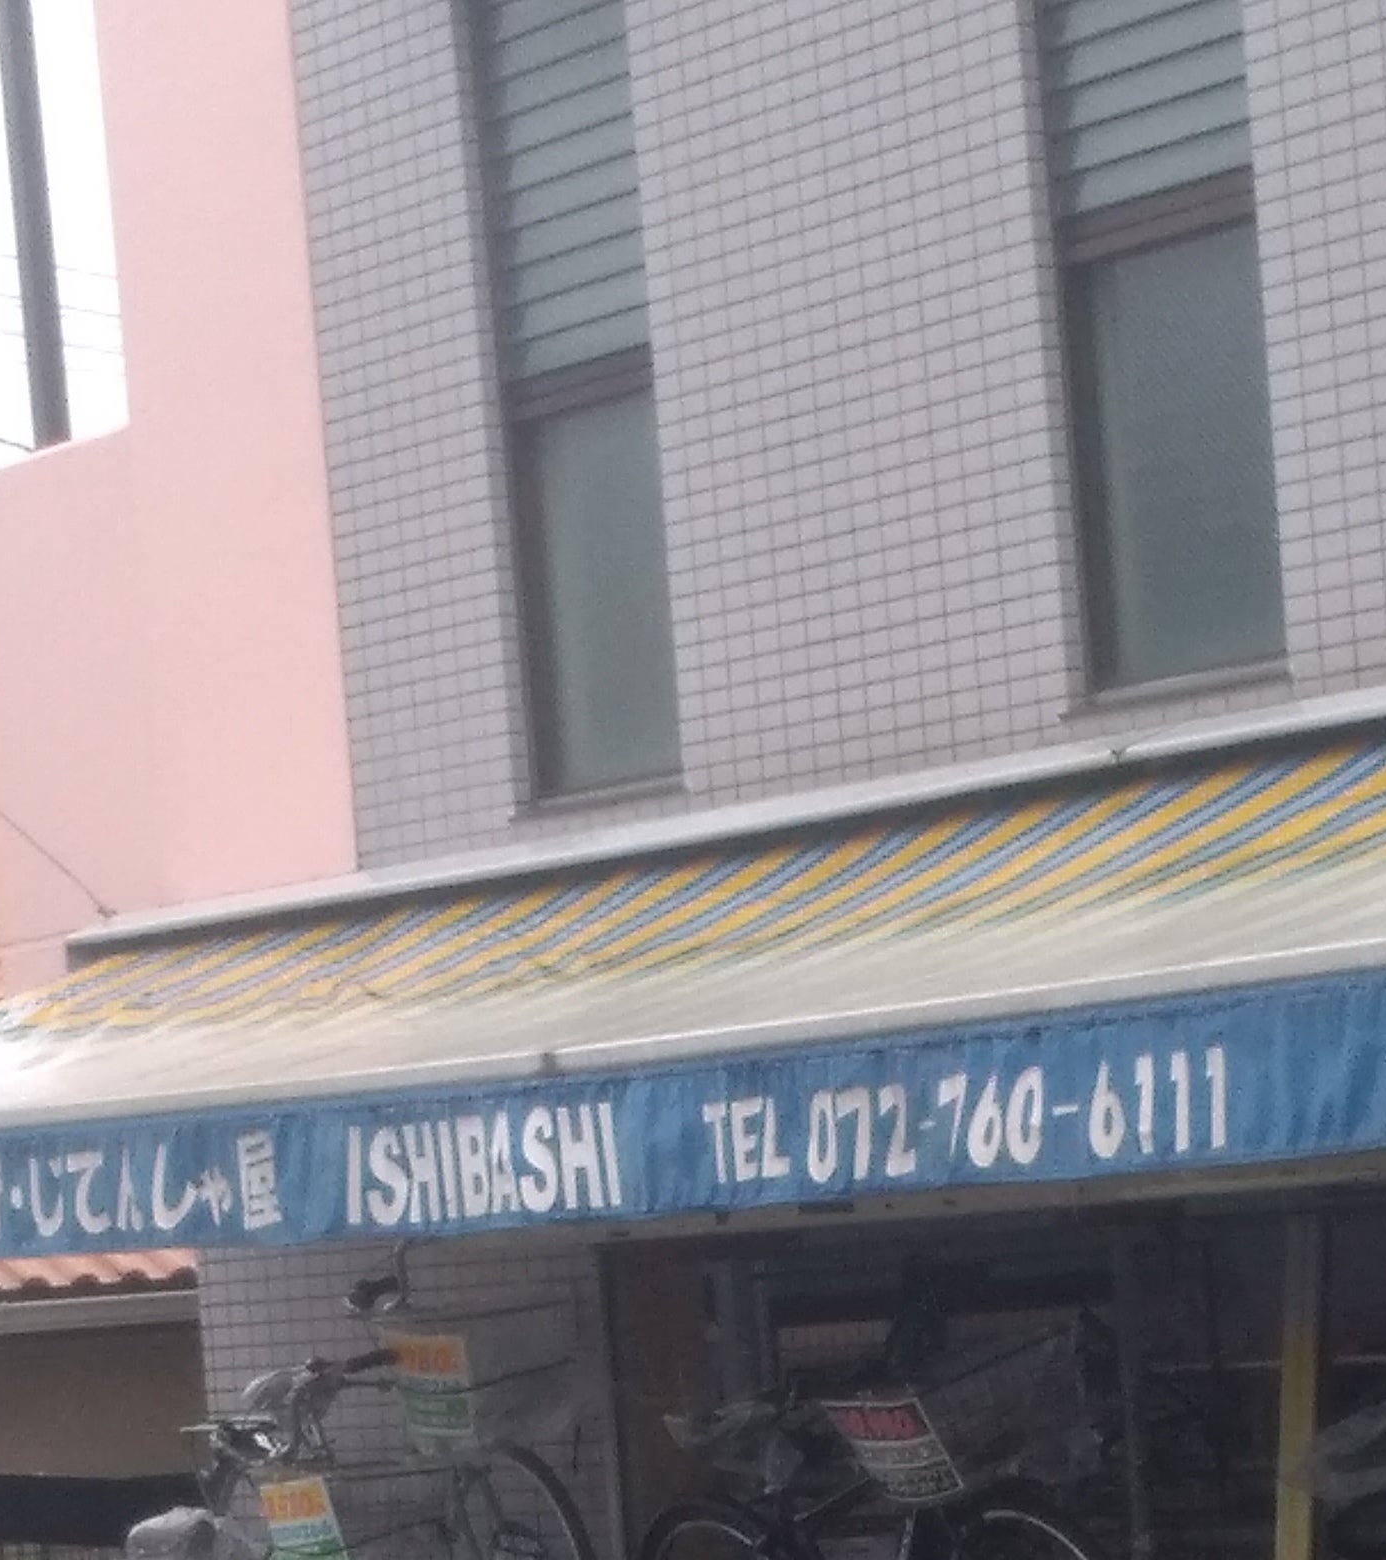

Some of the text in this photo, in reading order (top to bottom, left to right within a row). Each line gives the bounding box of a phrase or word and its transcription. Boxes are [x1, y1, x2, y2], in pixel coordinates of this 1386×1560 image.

[346, 1103, 622, 1226] ISHIBASHI
[703, 1046, 1226, 1184] TEL 072-760-6111
